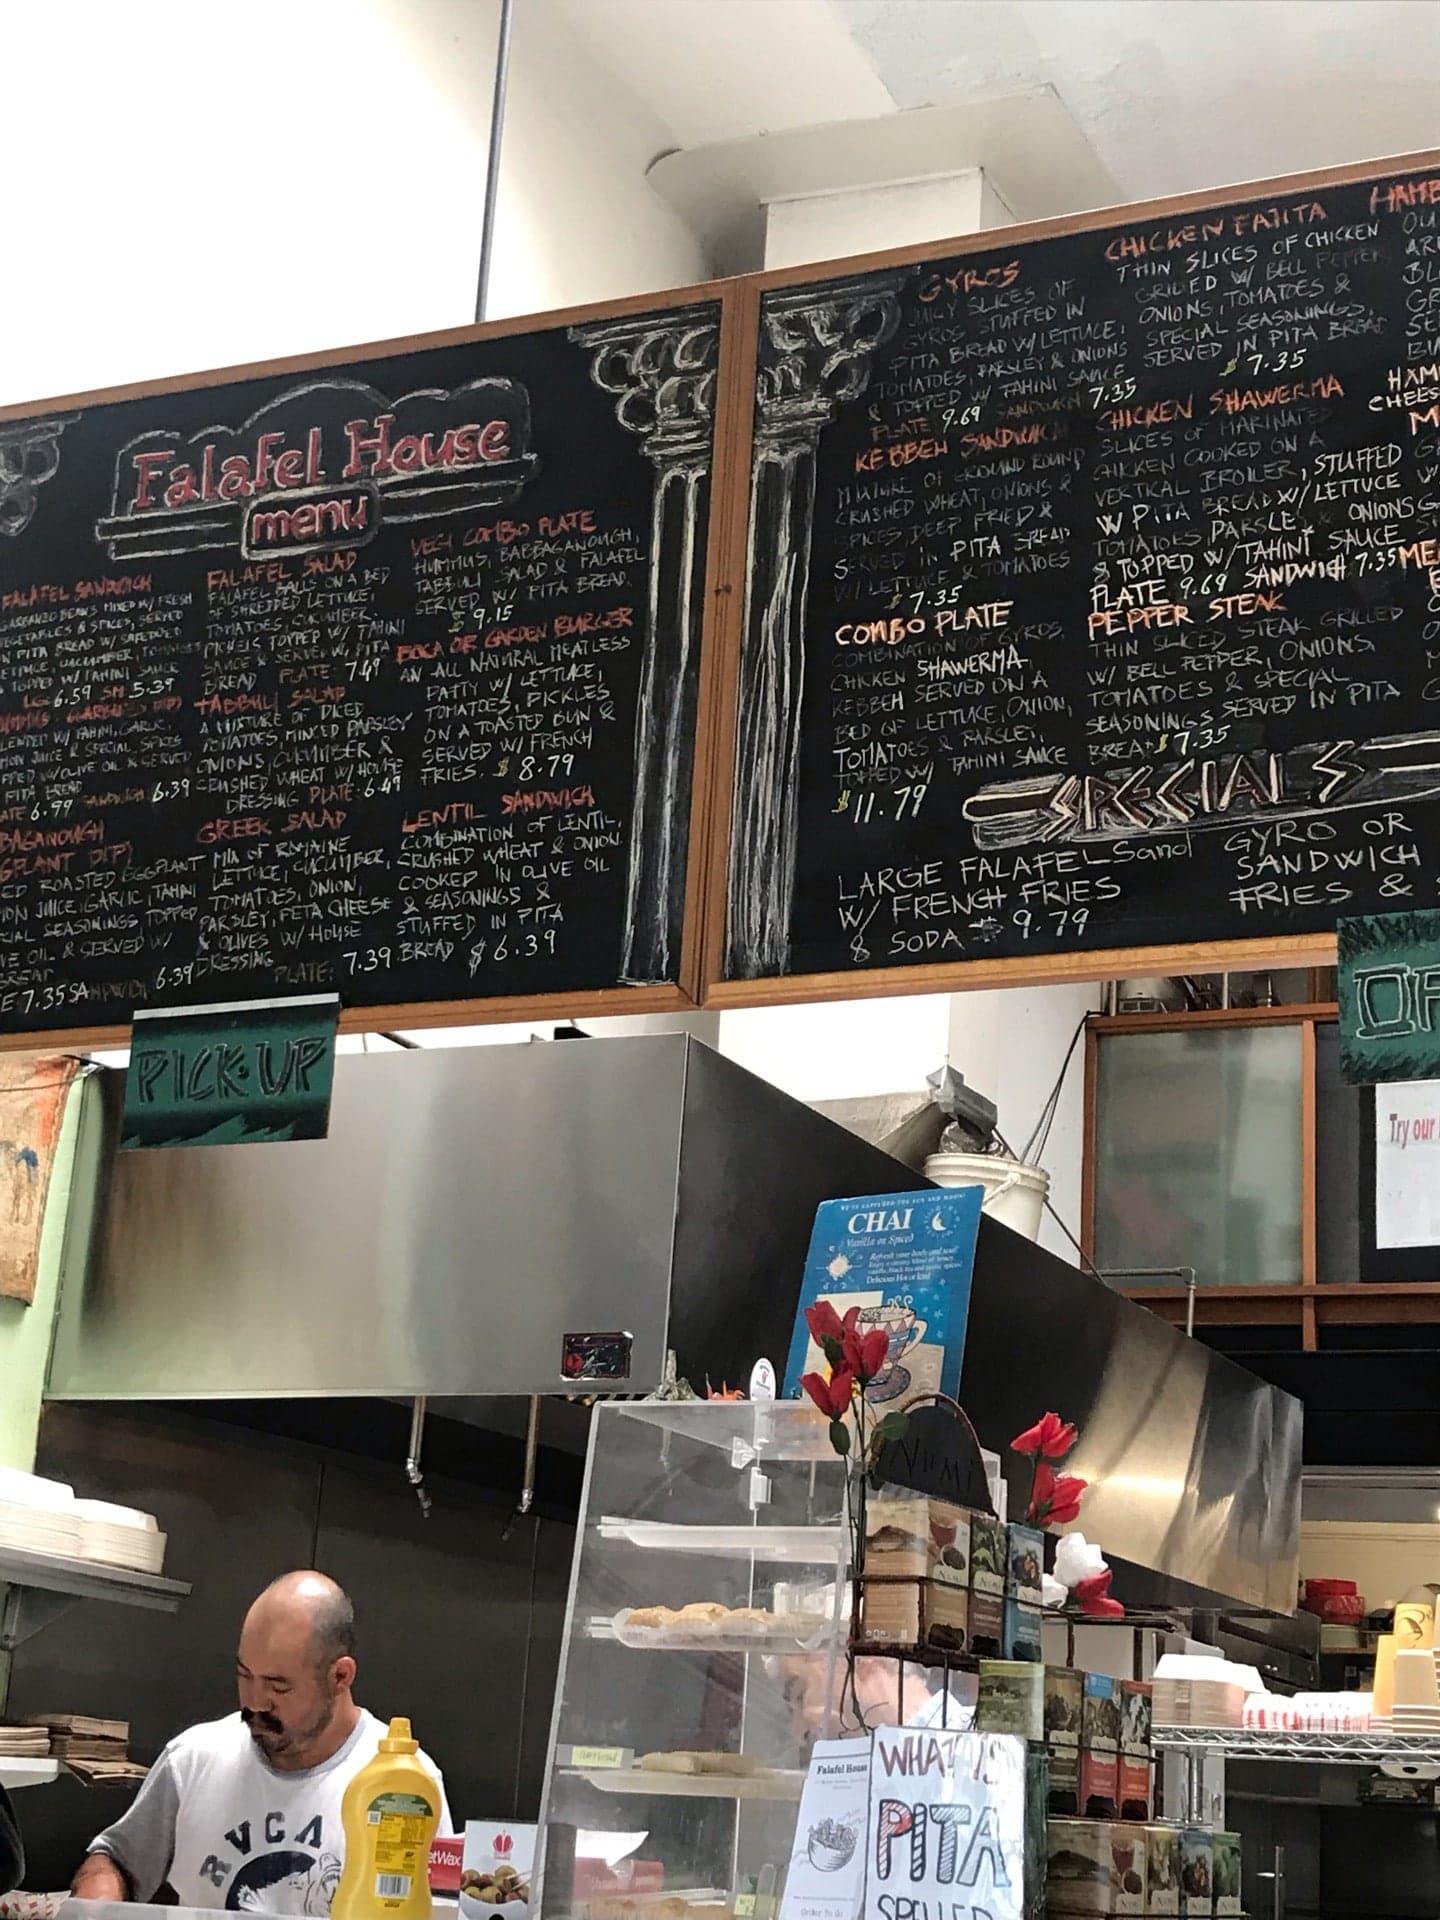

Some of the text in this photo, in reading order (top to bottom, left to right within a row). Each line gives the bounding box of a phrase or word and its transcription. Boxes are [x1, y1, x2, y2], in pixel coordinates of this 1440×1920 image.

[1104, 219, 1224, 262] CHICKEN
[1117, 219, 1380, 285] THIN SLICES OF CHICKEN
[920, 260, 1019, 302] GYROS
[1223, 279, 1325, 309] TOMATOES
[1066, 297, 1085, 318] IN
[1144, 343, 1222, 368] SERVED
[1269, 325, 1319, 348] PITA
[1146, 322, 1228, 348] SPECIAL
[950, 340, 1007, 365] BREAD
[1246, 349, 1308, 376] 7.35
[942, 377, 1137, 433] 9.69 7.35
[1097, 375, 1344, 430] CHICKEN SHAWERMA
[341, 413, 510, 478] House
[1314, 443, 1402, 477] STUFFED
[250, 495, 368, 542] menu
[539, 509, 597, 537] PLATE
[951, 536, 1001, 561] PITA
[1327, 525, 1406, 551] SAUCE
[208, 551, 358, 590] FALAFEL SALAD
[580, 548, 647, 571] FALAFEL
[1090, 547, 1396, 613] PLATE 7.35
[415, 592, 480, 615] SERVED
[910, 585, 963, 614] 7.35
[1088, 590, 1288, 640] PEPPER STEAK
[473, 605, 514, 630] 9.15
[835, 600, 1014, 645] COMBO PLATE
[1238, 617, 1312, 639] STEAK
[550, 636, 631, 661] MEATLESS
[54, 678, 175, 708] 6.59 5.39
[427, 681, 479, 702] PATTY
[527, 682, 611, 707] PICKLES
[915, 670, 1048, 703] SERVED ON A
[1087, 666, 1352, 708] TOMATOES SPECIAL
[1221, 680, 1401, 718] SERVED IN PITA
[424, 724, 451, 744] ON
[458, 724, 470, 739] A
[473, 713, 544, 735] TOASTED
[1173, 724, 1232, 756] 7.35
[422, 742, 492, 764] SERVED
[530, 726, 593, 752] FRENCH
[833, 740, 929, 772] TOMATOES
[519, 753, 575, 781] 8.79
[152, 780, 191, 802] 6.39
[854, 784, 927, 823] 11.79
[1042, 748, 1365, 843] SPECIALS
[30, 800, 73, 821] 6.99
[281, 810, 347, 833] SALAD
[401, 785, 596, 833] LENTIL SANDWICH
[1224, 812, 1414, 853] GYRO OR
[483, 841, 544, 865] WHEAT
[1236, 844, 1421, 881] SANDWICH
[40, 871, 116, 892] ROASTED
[398, 870, 478, 891] COOKED
[495, 863, 511, 883] IN
[583, 857, 611, 873] OIL
[838, 849, 1107, 903] LARGE FALAFEL
[425, 886, 521, 911] SEASONINGS
[890, 888, 1007, 924] FRENCH
[1018, 876, 1122, 905] FRIES
[1227, 873, 1414, 914] FRIES &
[280, 902, 323, 922] FETA
[396, 903, 564, 941] STUFFED IN PITA
[494, 929, 556, 961] 6.39
[888, 926, 966, 956] SODA
[1012, 908, 1090, 940] 9.79
[342, 946, 392, 975] 7.39
[21, 961, 195, 1014] 7.35 6.39
[1390, 1114, 1435, 1149] Try our
[848, 1207, 914, 1234] CHAI
[817, 1763, 844, 1775] Falafel
[200, 1811, 323, 1887] RVCA
[877, 1799, 1012, 1888] PITA
